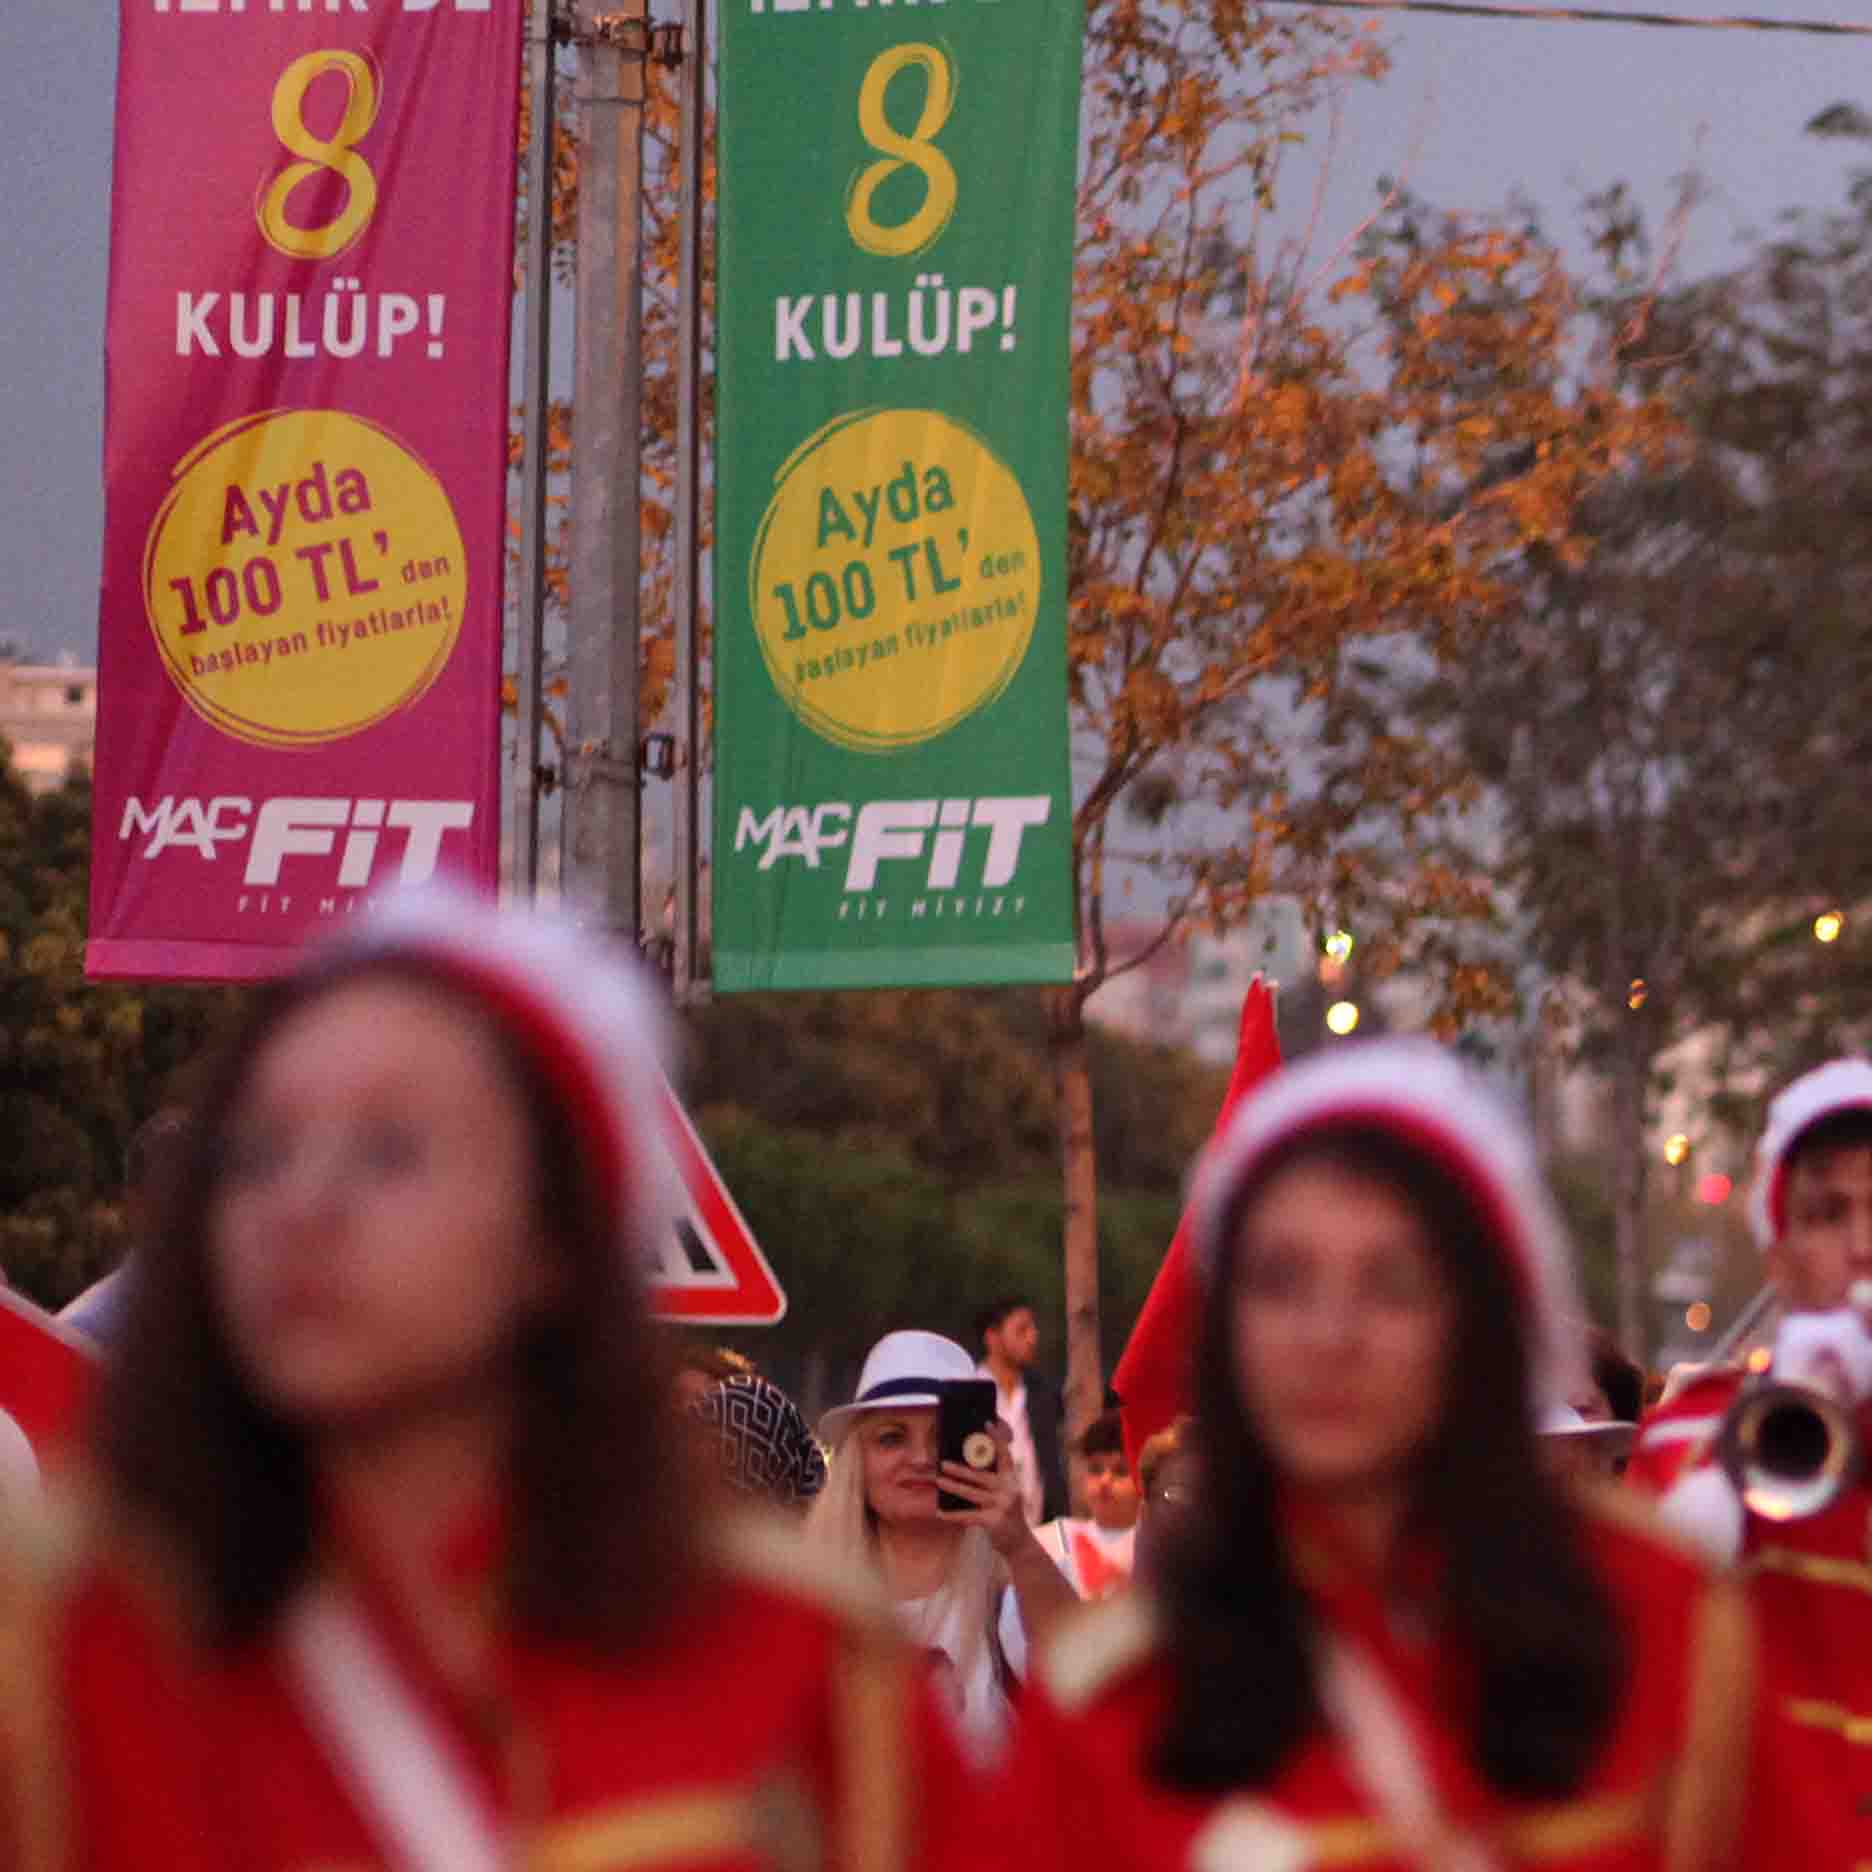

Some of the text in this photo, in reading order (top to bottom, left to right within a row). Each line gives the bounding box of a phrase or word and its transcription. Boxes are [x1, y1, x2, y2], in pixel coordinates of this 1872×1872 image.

[257, 48, 382, 260] 8
[847, 42, 957, 256] 8
[176, 277, 446, 358] KULÜP!
[775, 274, 1016, 361] KULÜP!
[219, 461, 371, 546] Ayda
[816, 461, 954, 548] Ayda
[169, 556, 282, 636] 100
[772, 560, 875, 640] 100
